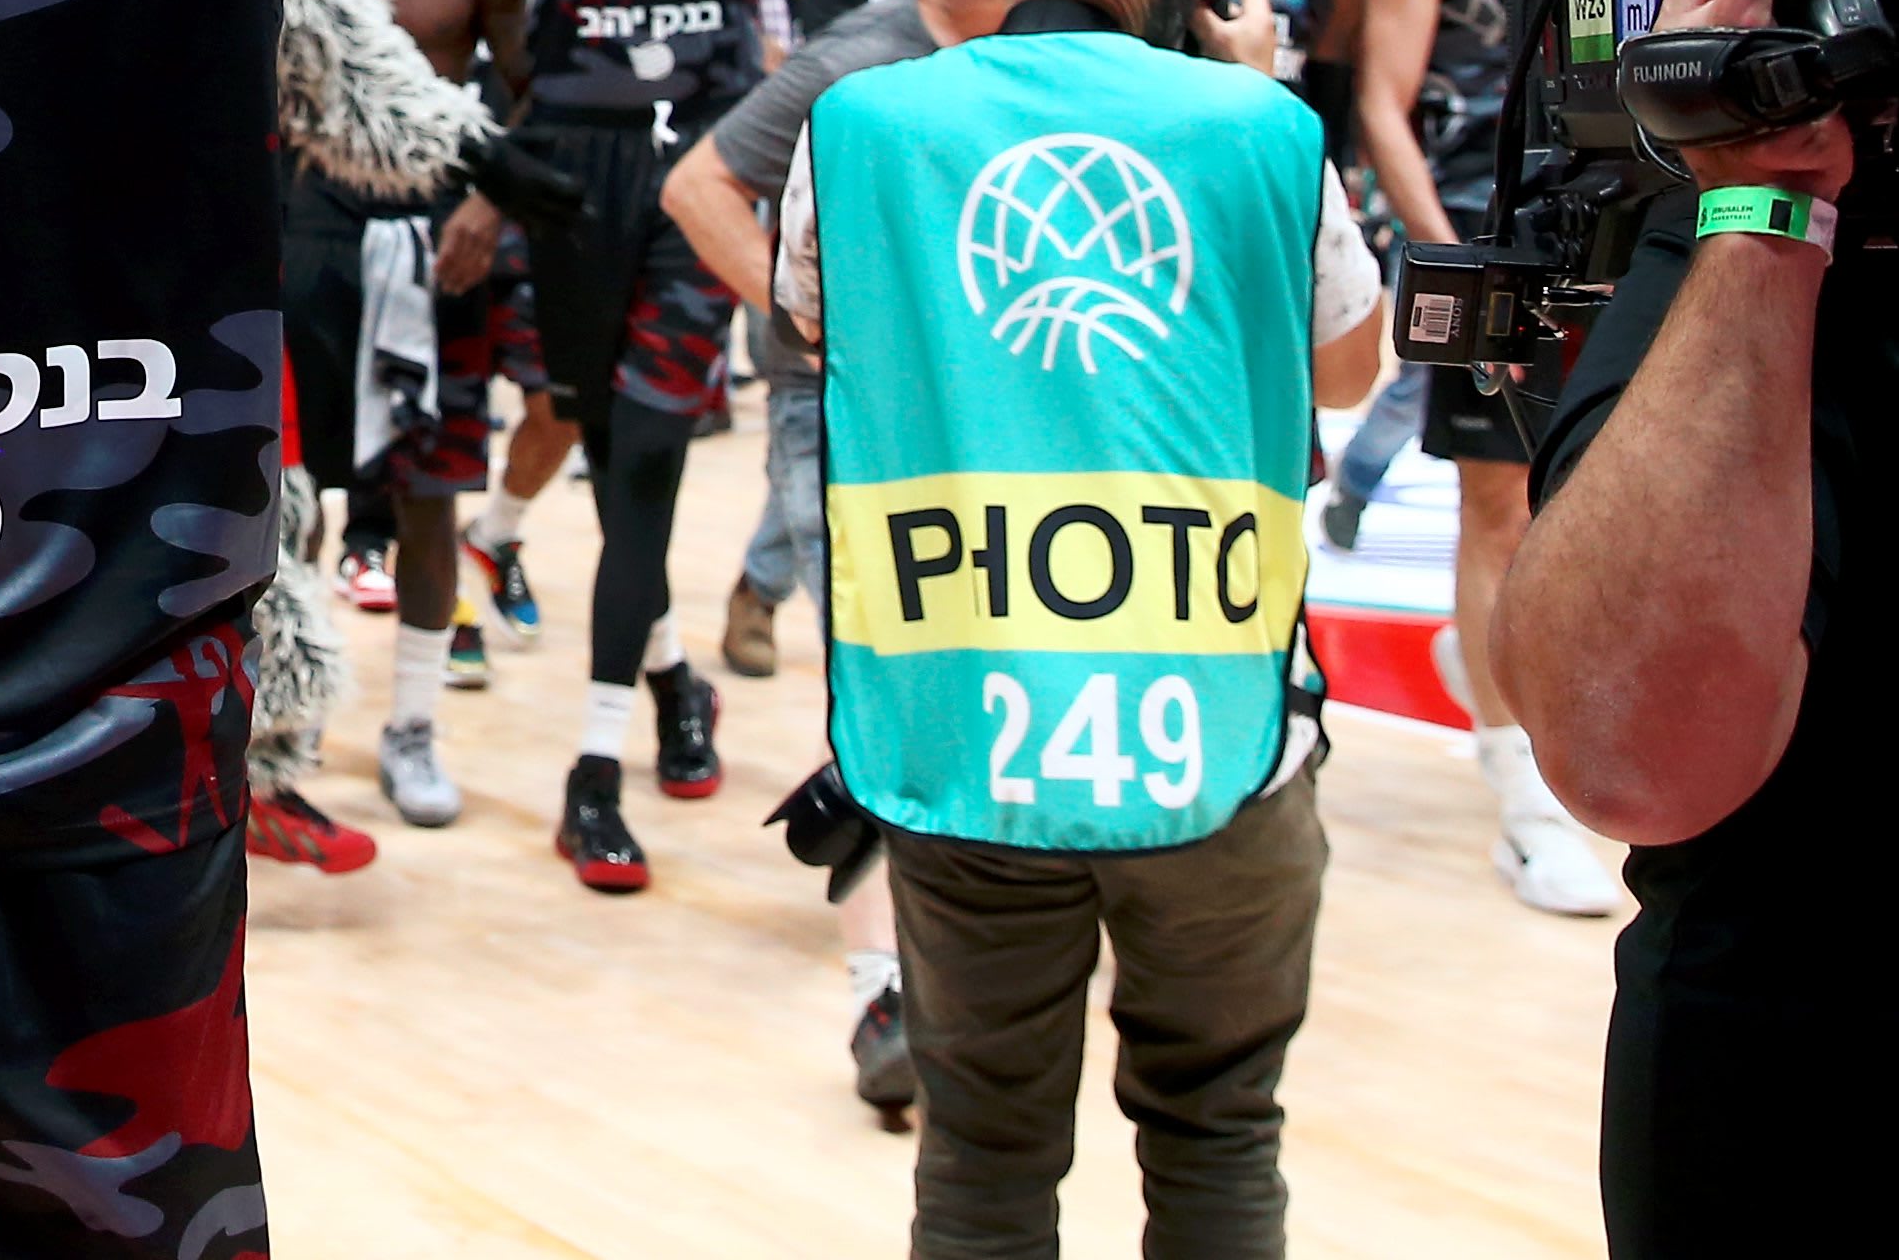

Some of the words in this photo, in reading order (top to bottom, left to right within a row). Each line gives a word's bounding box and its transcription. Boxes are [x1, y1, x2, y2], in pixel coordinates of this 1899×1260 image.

[576, 5, 647, 38] יהב
[651, 0, 724, 43] בנק
[1633, 61, 1702, 83] FUJINON
[1450, 297, 1464, 339] SONY
[887, 504, 1259, 623] PHOTO
[983, 671, 1202, 809] 249
